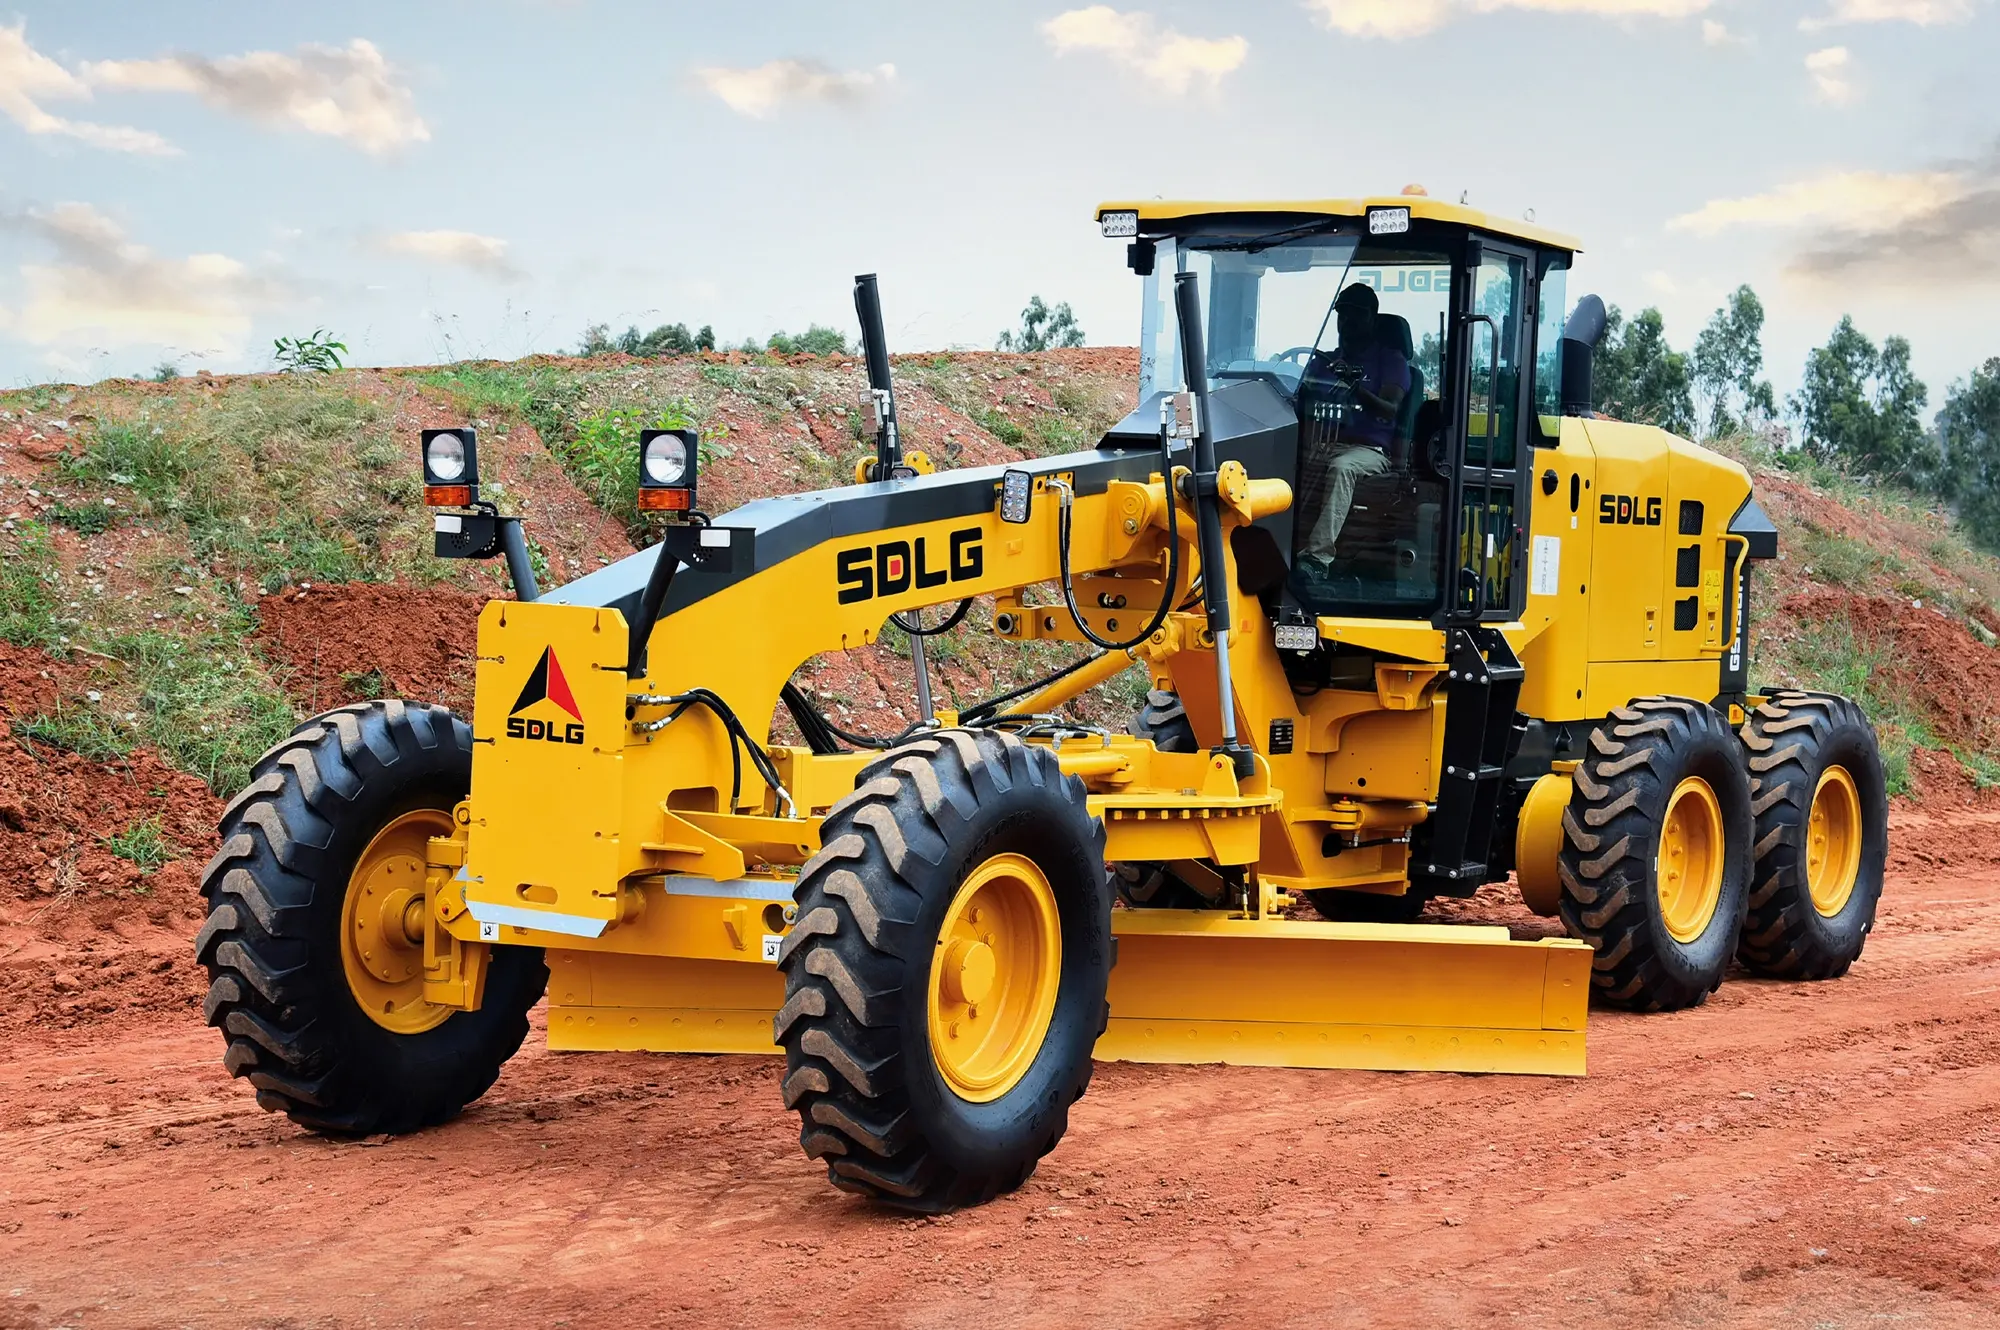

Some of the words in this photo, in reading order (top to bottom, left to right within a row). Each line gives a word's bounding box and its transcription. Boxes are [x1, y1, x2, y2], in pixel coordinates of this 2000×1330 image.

[1599, 494, 1662, 526] SDLG
[837, 527, 983, 605] SDLG
[506, 717, 584, 745] SDLG
